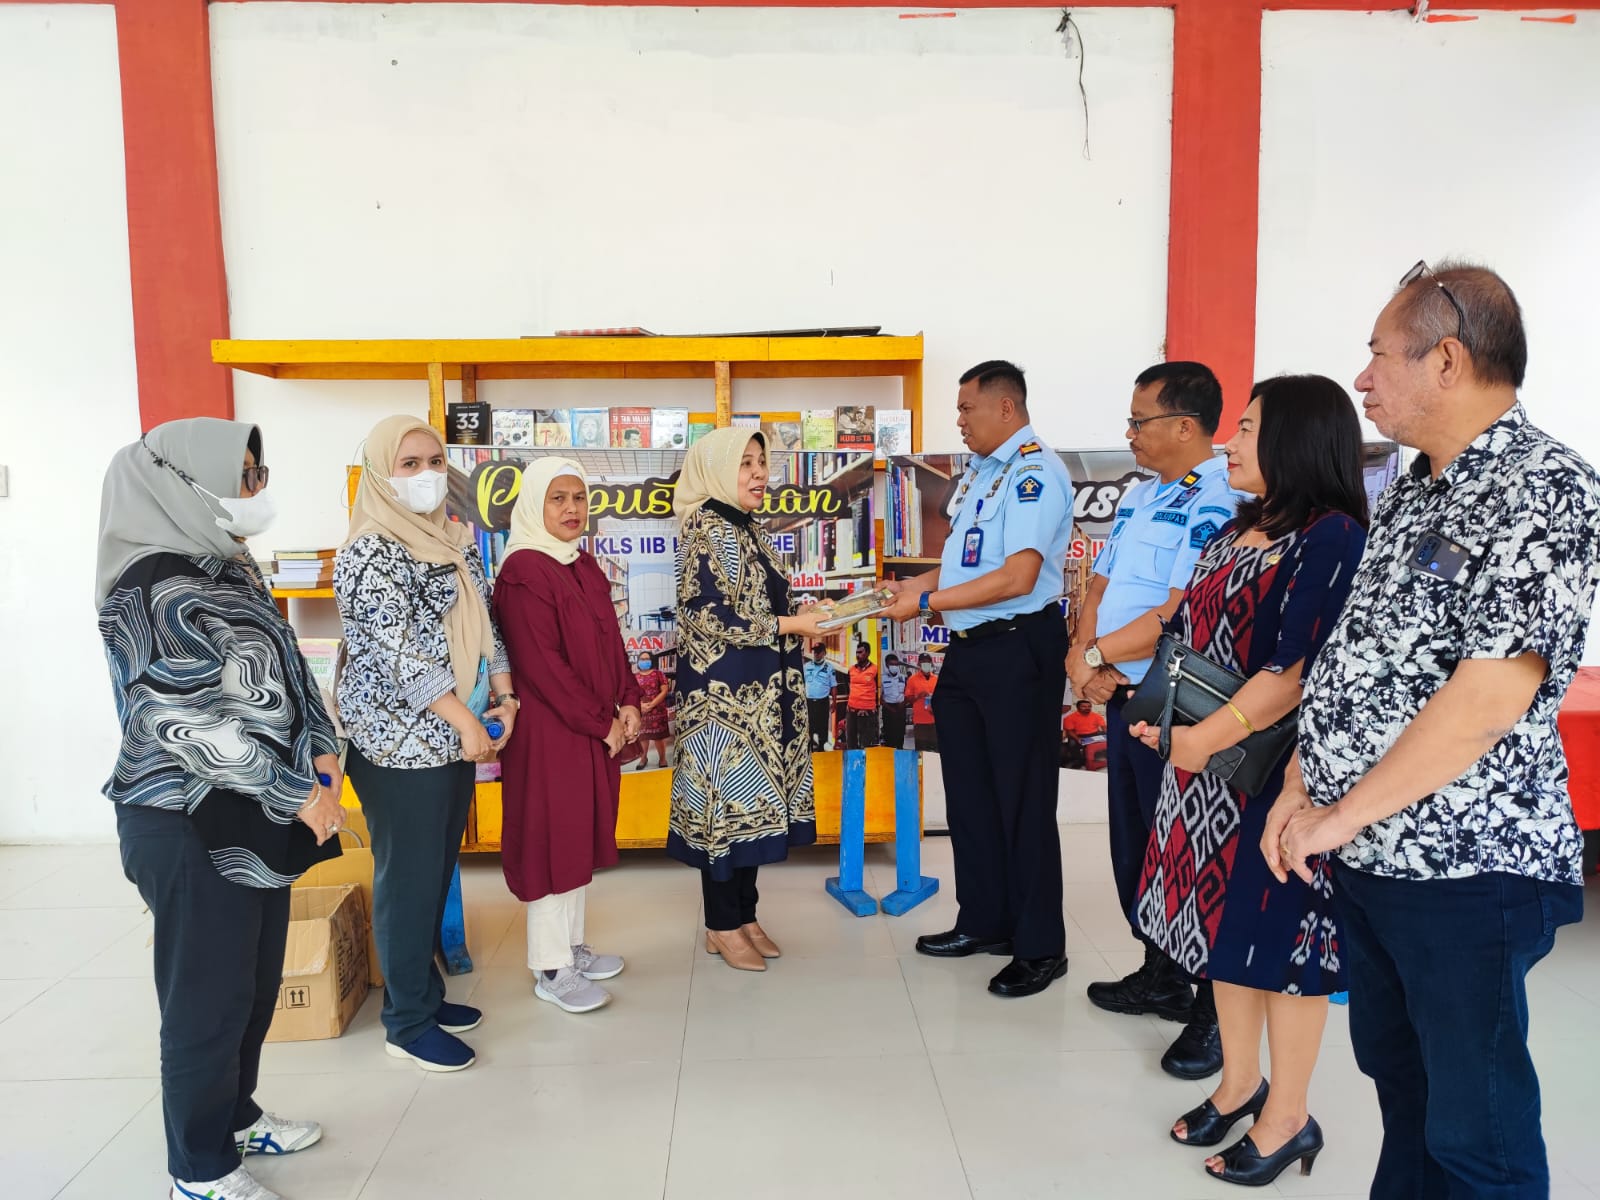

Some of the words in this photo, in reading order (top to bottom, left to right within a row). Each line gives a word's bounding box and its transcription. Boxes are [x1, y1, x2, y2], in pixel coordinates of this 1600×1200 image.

[456, 412, 479, 430] 33
[595, 537, 633, 554] KLS
[640, 537, 665, 554] IIB
